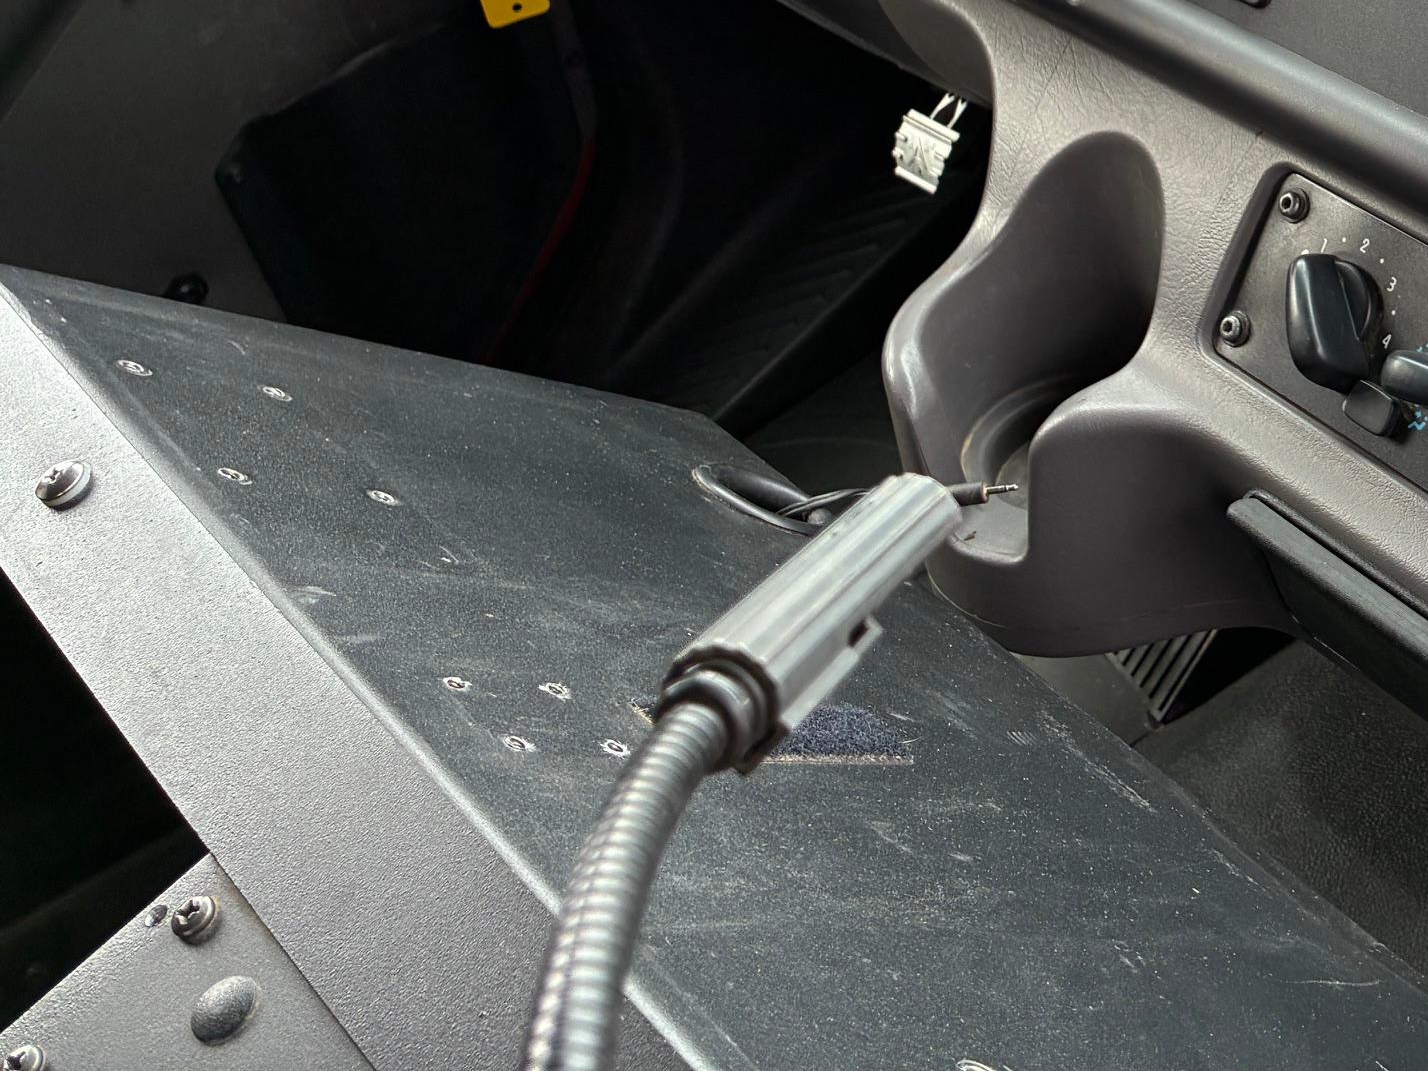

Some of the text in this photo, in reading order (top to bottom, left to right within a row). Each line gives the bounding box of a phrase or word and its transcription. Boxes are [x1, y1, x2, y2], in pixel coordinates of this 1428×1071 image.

[1321, 237, 1328, 254] 1
[1360, 238, 1370, 254] 2
[1386, 276, 1397, 292] 3
[1382, 334, 1392, 349] 4
